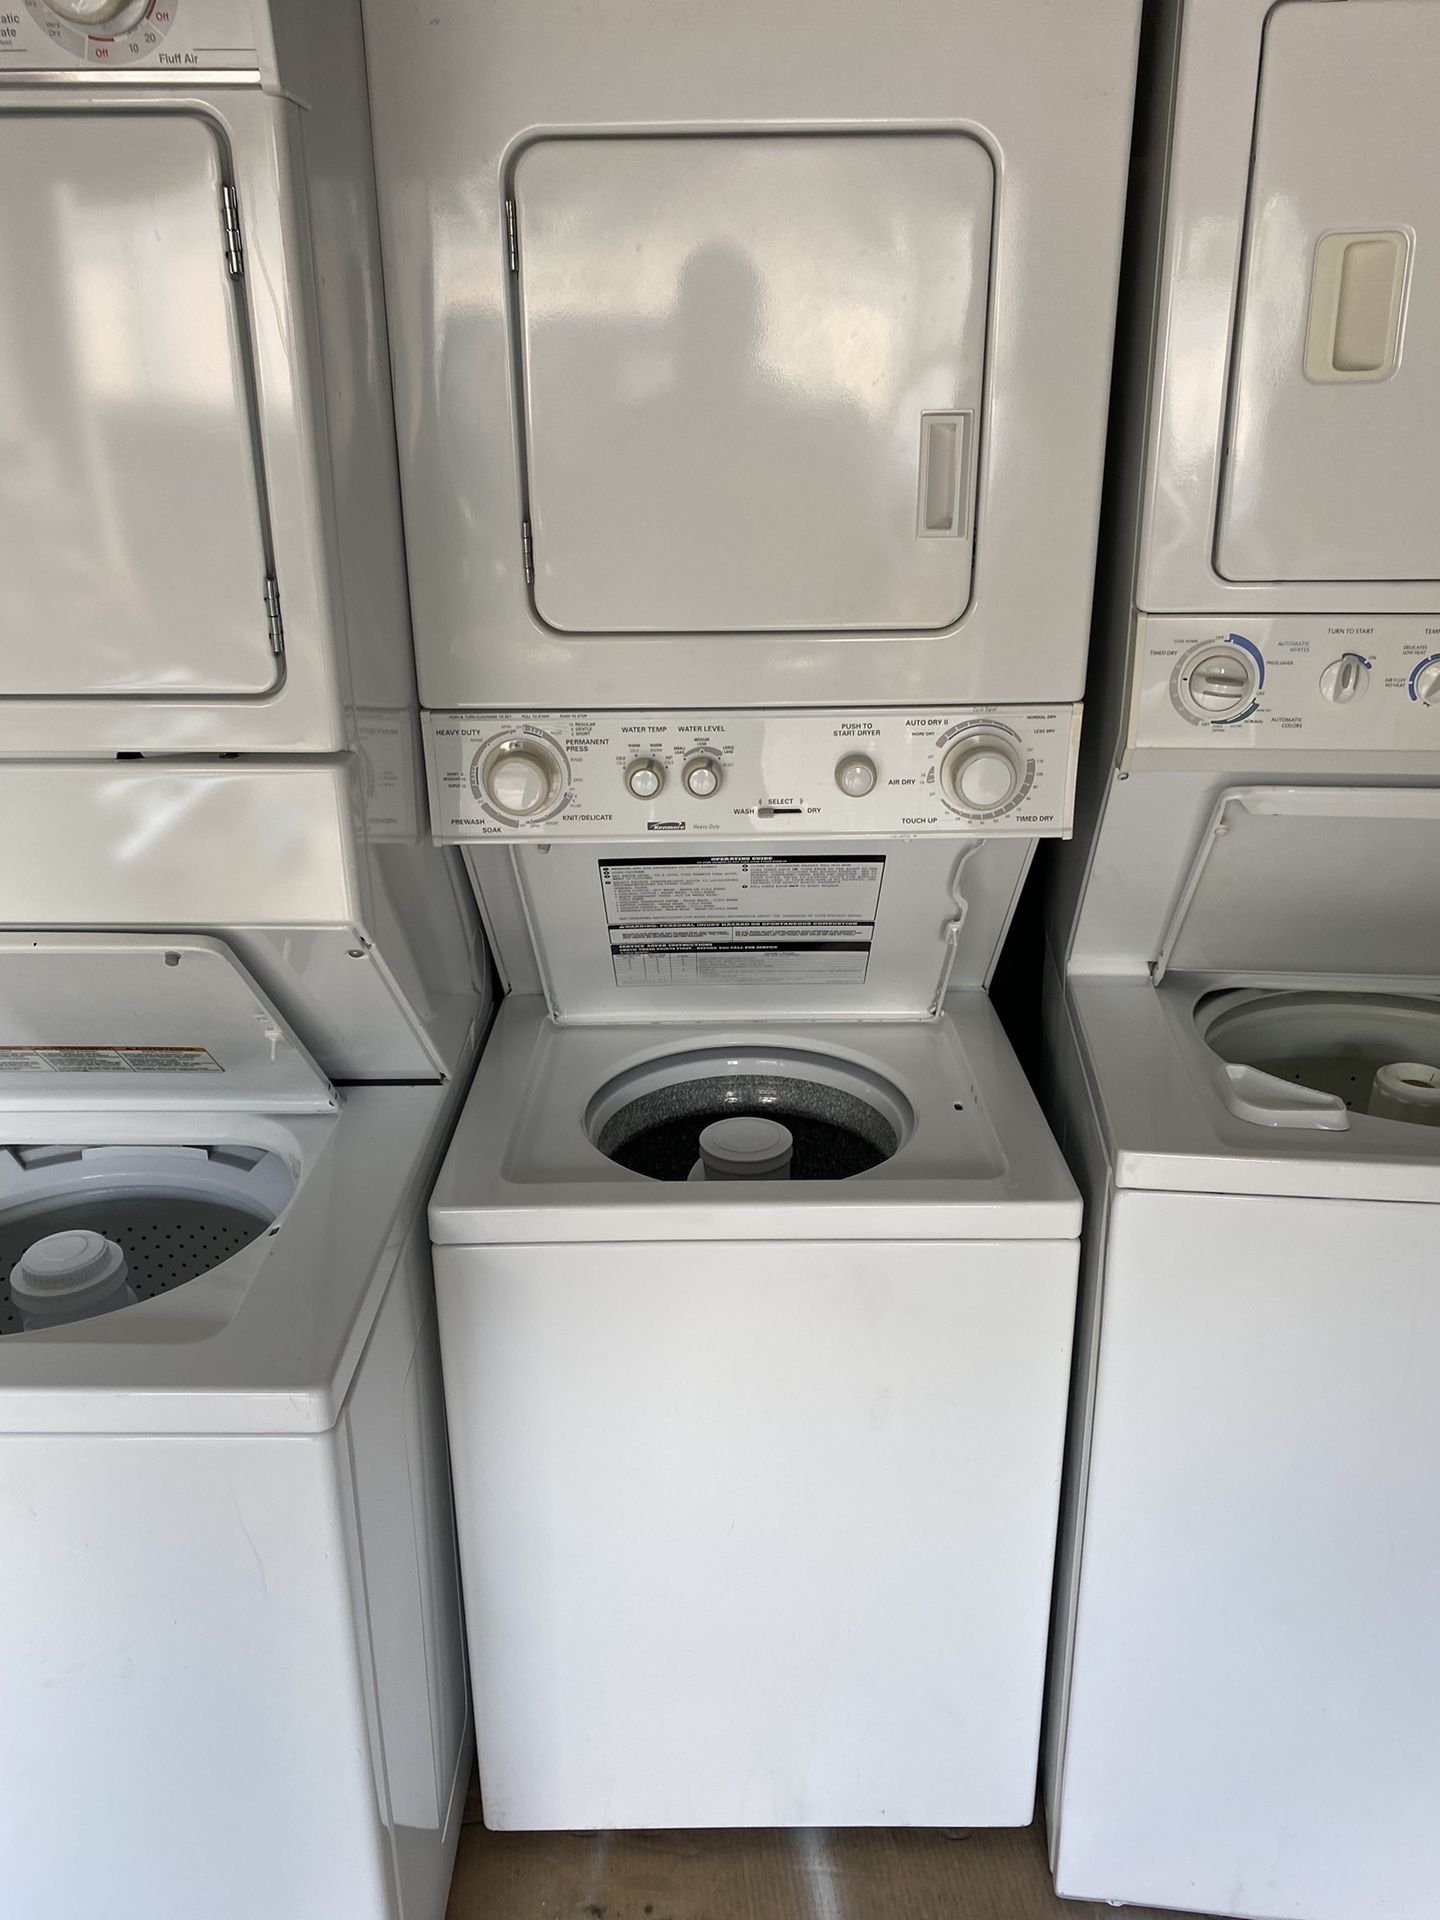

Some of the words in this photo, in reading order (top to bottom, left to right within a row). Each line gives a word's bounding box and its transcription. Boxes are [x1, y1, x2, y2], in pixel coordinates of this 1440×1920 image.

[156, 12, 169, 21] Off
[144, 33, 156, 43] 20
[96, 48, 108, 58] Off
[129, 43, 139, 53] 10
[159, 53, 181, 64] Fluff
[184, 54, 198, 64] Air
[653, 823, 685, 831] Kenmore
